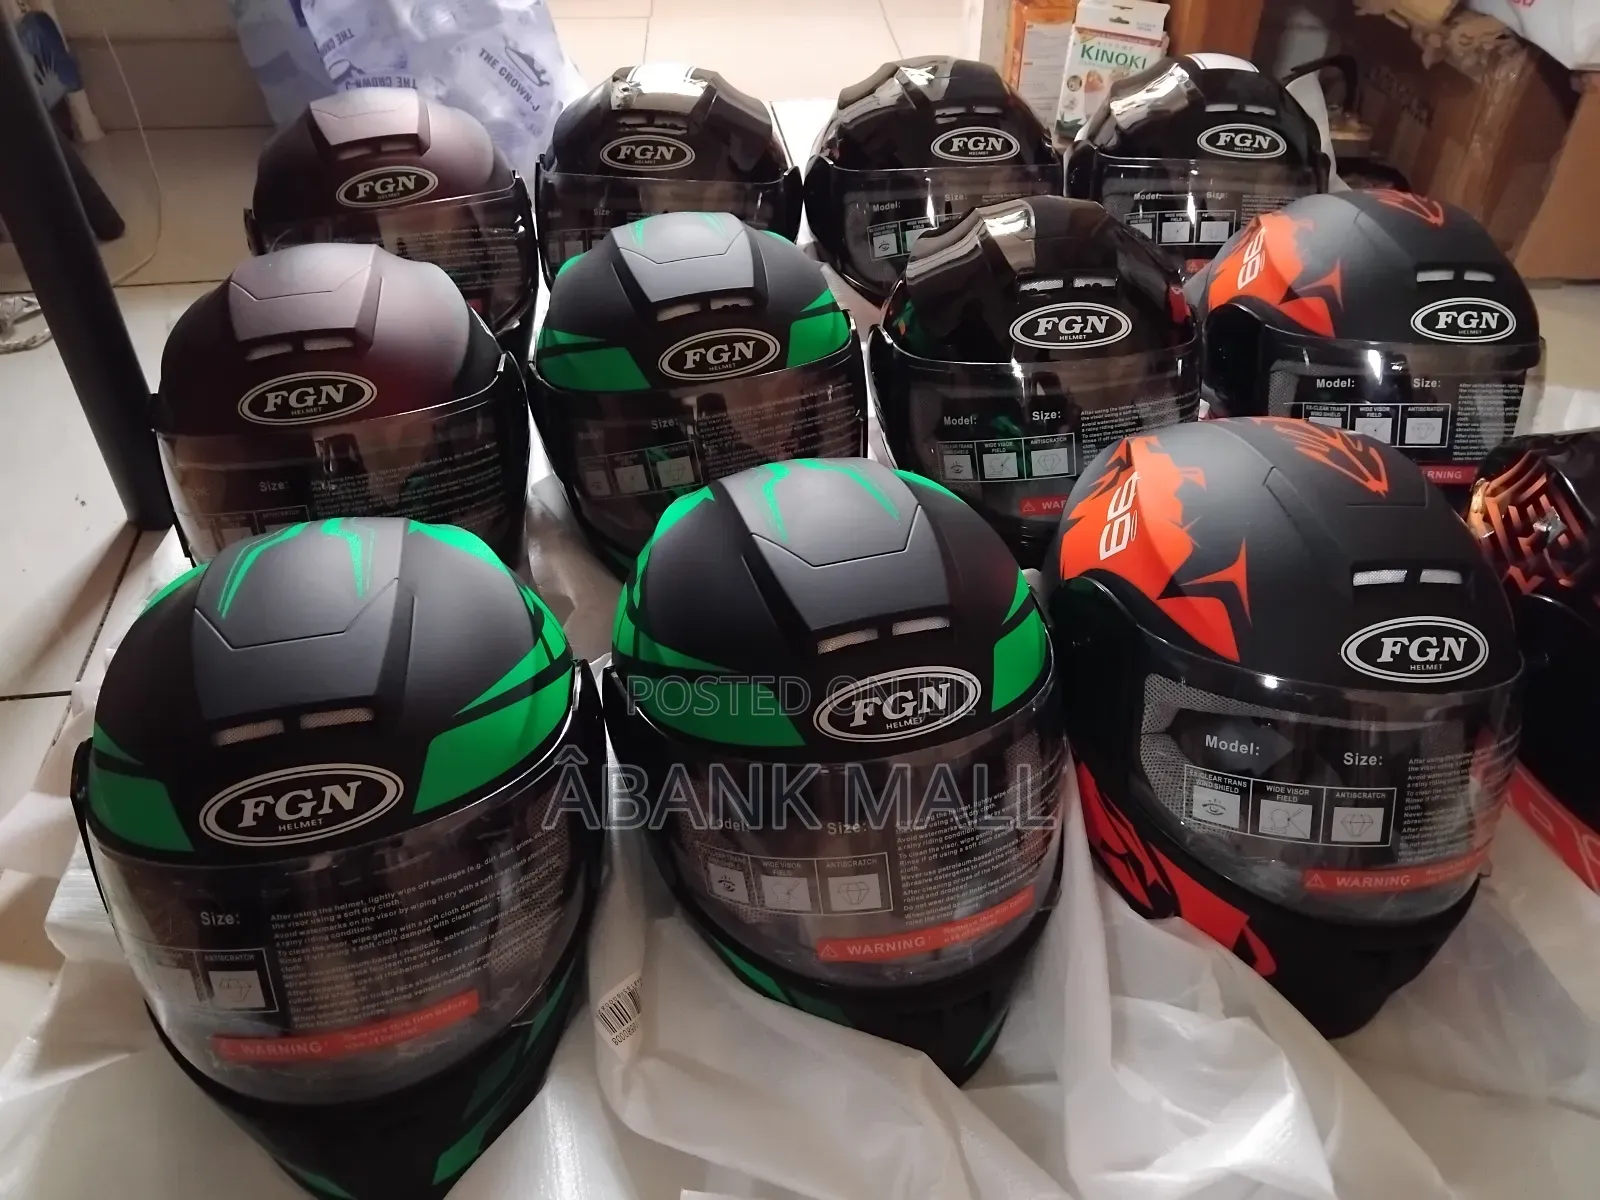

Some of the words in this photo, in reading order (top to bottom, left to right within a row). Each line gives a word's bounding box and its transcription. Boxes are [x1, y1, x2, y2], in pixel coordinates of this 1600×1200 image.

[1080, 44, 1147, 70] KINOKI
[479, 47, 499, 70] THE
[499, 66, 540, 112] CROWN-J
[950, 136, 1004, 152] FGN
[1216, 132, 1272, 149] FGN
[617, 145, 676, 160] FGN
[356, 174, 417, 199] FGN
[944, 194, 967, 202] Size:
[1206, 191, 1228, 200] Size:
[593, 208, 613, 216] Size:
[873, 201, 901, 212] Model:
[1034, 315, 1110, 336] FGN
[1435, 310, 1500, 330] FGN
[683, 341, 756, 370] FGN
[708, 363, 737, 372] HELMET
[1316, 378, 1355, 388] Model:
[1413, 378, 1441, 388] Size:
[263, 383, 348, 412] FGN
[291, 406, 323, 416] HELMET
[1032, 410, 1061, 420] Size:
[650, 418, 679, 430] Size:
[943, 416, 977, 426] Model:
[1427, 470, 1462, 479] RNING
[260, 481, 289, 492] Size:
[1377, 636, 1468, 663] FGN
[1410, 663, 1443, 671] HELMET
[849, 682, 951, 728] FGN
[885, 716, 925, 731] HELMET
[1205, 735, 1260, 756] Model:
[1343, 752, 1383, 766] Size:
[1214, 784, 1239, 794] SHIELD
[1224, 777, 1247, 788] TRANS
[1266, 785, 1285, 794] WIDE
[1287, 788, 1309, 796] VISOR
[237, 780, 362, 829] FGN
[278, 818, 324, 832] HELMET
[827, 821, 868, 835] Size:
[929, 819, 949, 828] using
[897, 835, 917, 843] Avoid
[919, 825, 958, 839] watermarks
[903, 841, 922, 850] rainy
[923, 836, 943, 846] riding
[944, 827, 977, 840] condition.
[909, 849, 928, 858] clean
[941, 841, 959, 850] visor,
[960, 836, 975, 845] wipe
[975, 829, 993, 841] gently
[900, 858, 920, 866] Rinse
[929, 853, 938, 861] off
[939, 849, 958, 859] using
[965, 842, 978, 851] soft
[827, 859, 877, 868] ANTISCRATCH
[901, 871, 923, 880] Never
[938, 852, 992, 873] petroleum-based
[902, 878, 933, 887] abrasive
[934, 866, 970, 884] detergents
[979, 857, 995, 868] clean
[903, 888, 922, 896] After
[922, 880, 952, 893] cleaning
[1336, 874, 1410, 888] WARNING
[335, 900, 367, 911] helmet,
[368, 892, 395, 903] lightly
[397, 887, 416, 896] wipe
[418, 882, 429, 890] off
[431, 869, 465, 885] smudges
[903, 895, 925, 903] rolled
[926, 891, 939, 899] and
[928, 897, 944, 905] wear
[274, 931, 297, 939] Avoid
[299, 923, 347, 936] watermarks
[377, 911, 397, 919] visor
[411, 897, 437, 911] wiping
[445, 891, 457, 900] dry
[459, 883, 474, 894] with
[311, 915, 335, 923] using
[344, 909, 361, 918] soft
[378, 899, 403, 909] cloth.
[200, 912, 240, 926] Size:
[352, 935, 371, 944] wipe
[373, 928, 398, 940] gently
[400, 923, 417, 931] with
[424, 913, 439, 925] soft
[440, 907, 459, 920] cloth
[460, 895, 488, 911] damped
[304, 934, 329, 943] riding
[330, 925, 373, 938] condition.
[378, 936, 398, 946] cloth
[400, 926, 431, 940] damped
[433, 919, 449, 929] with
[452, 911, 471, 923] clean
[400, 938, 443, 955] chemicals,
[444, 924, 479, 942] solvents,
[847, 936, 926, 956] WARNING
[419, 948, 443, 958] visor.
[431, 954, 451, 966] store
[470, 937, 487, 947] solid
